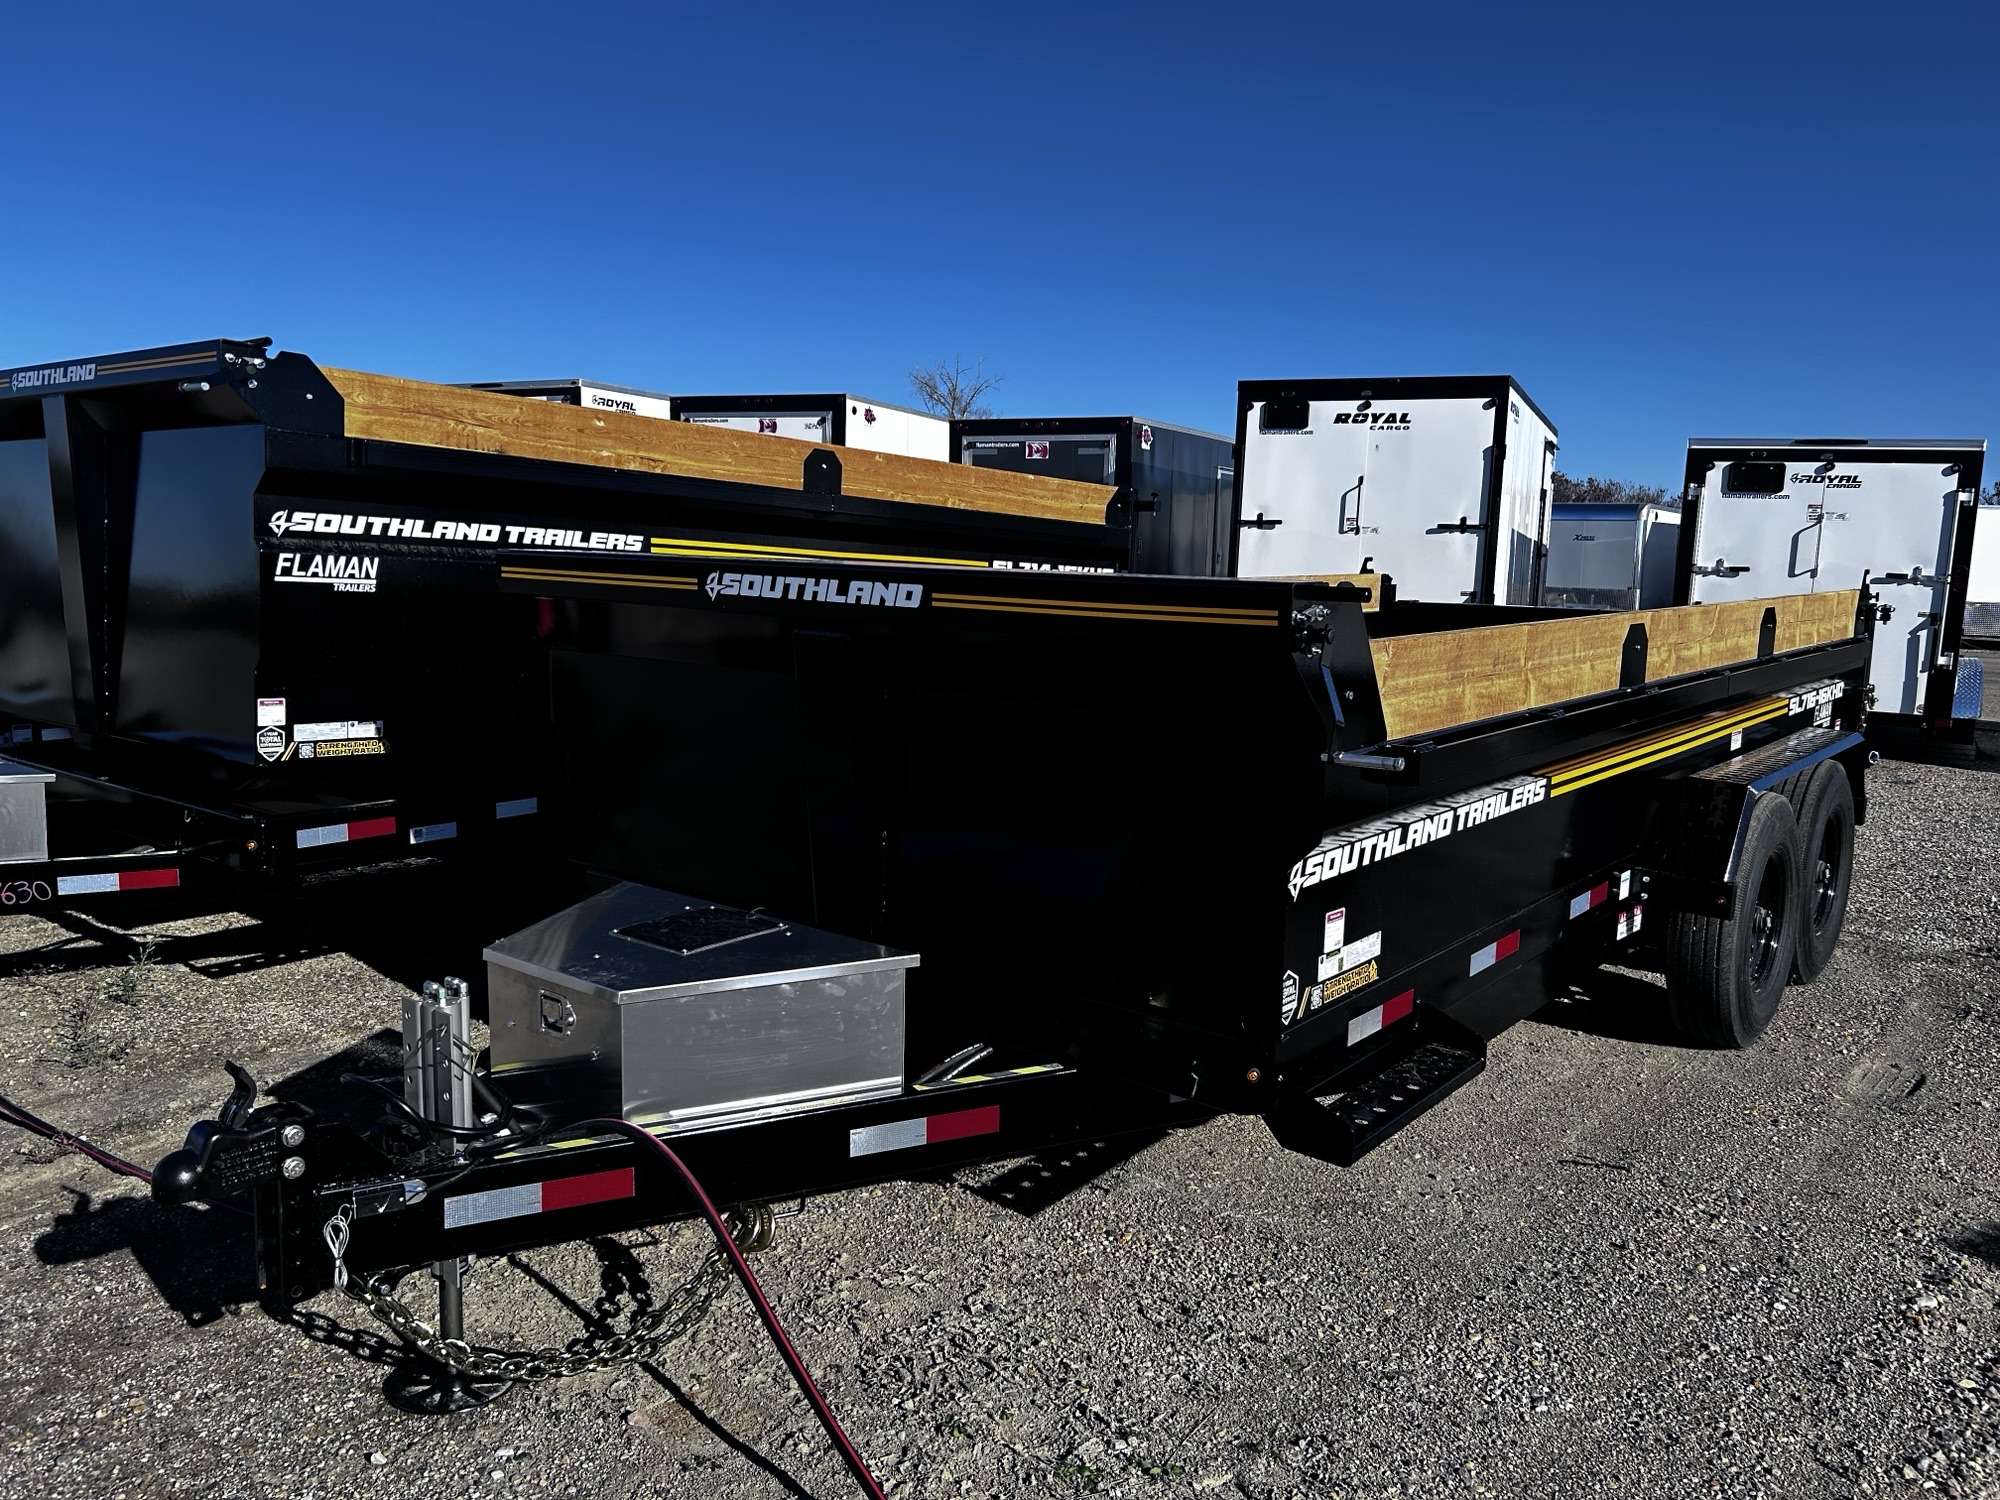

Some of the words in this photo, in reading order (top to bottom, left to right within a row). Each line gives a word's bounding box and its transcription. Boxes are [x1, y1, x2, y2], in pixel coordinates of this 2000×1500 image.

[17, 363, 97, 387] SOUTHLAND
[597, 397, 637, 411] ROYAL
[1333, 412, 1412, 424] ROYAL
[1799, 474, 1863, 484] ROYAL
[289, 511, 501, 543] SOUTHLAND
[505, 525, 645, 552] TRAILERS
[274, 552, 380, 580] FLAMAN
[333, 582, 377, 593] TRAILERS
[720, 572, 924, 609] SOUTHLAND
[1302, 810, 1454, 888] SOUTHLAND
[1456, 778, 1547, 832] TRAILERS
[0, 881, 52, 905] 630
